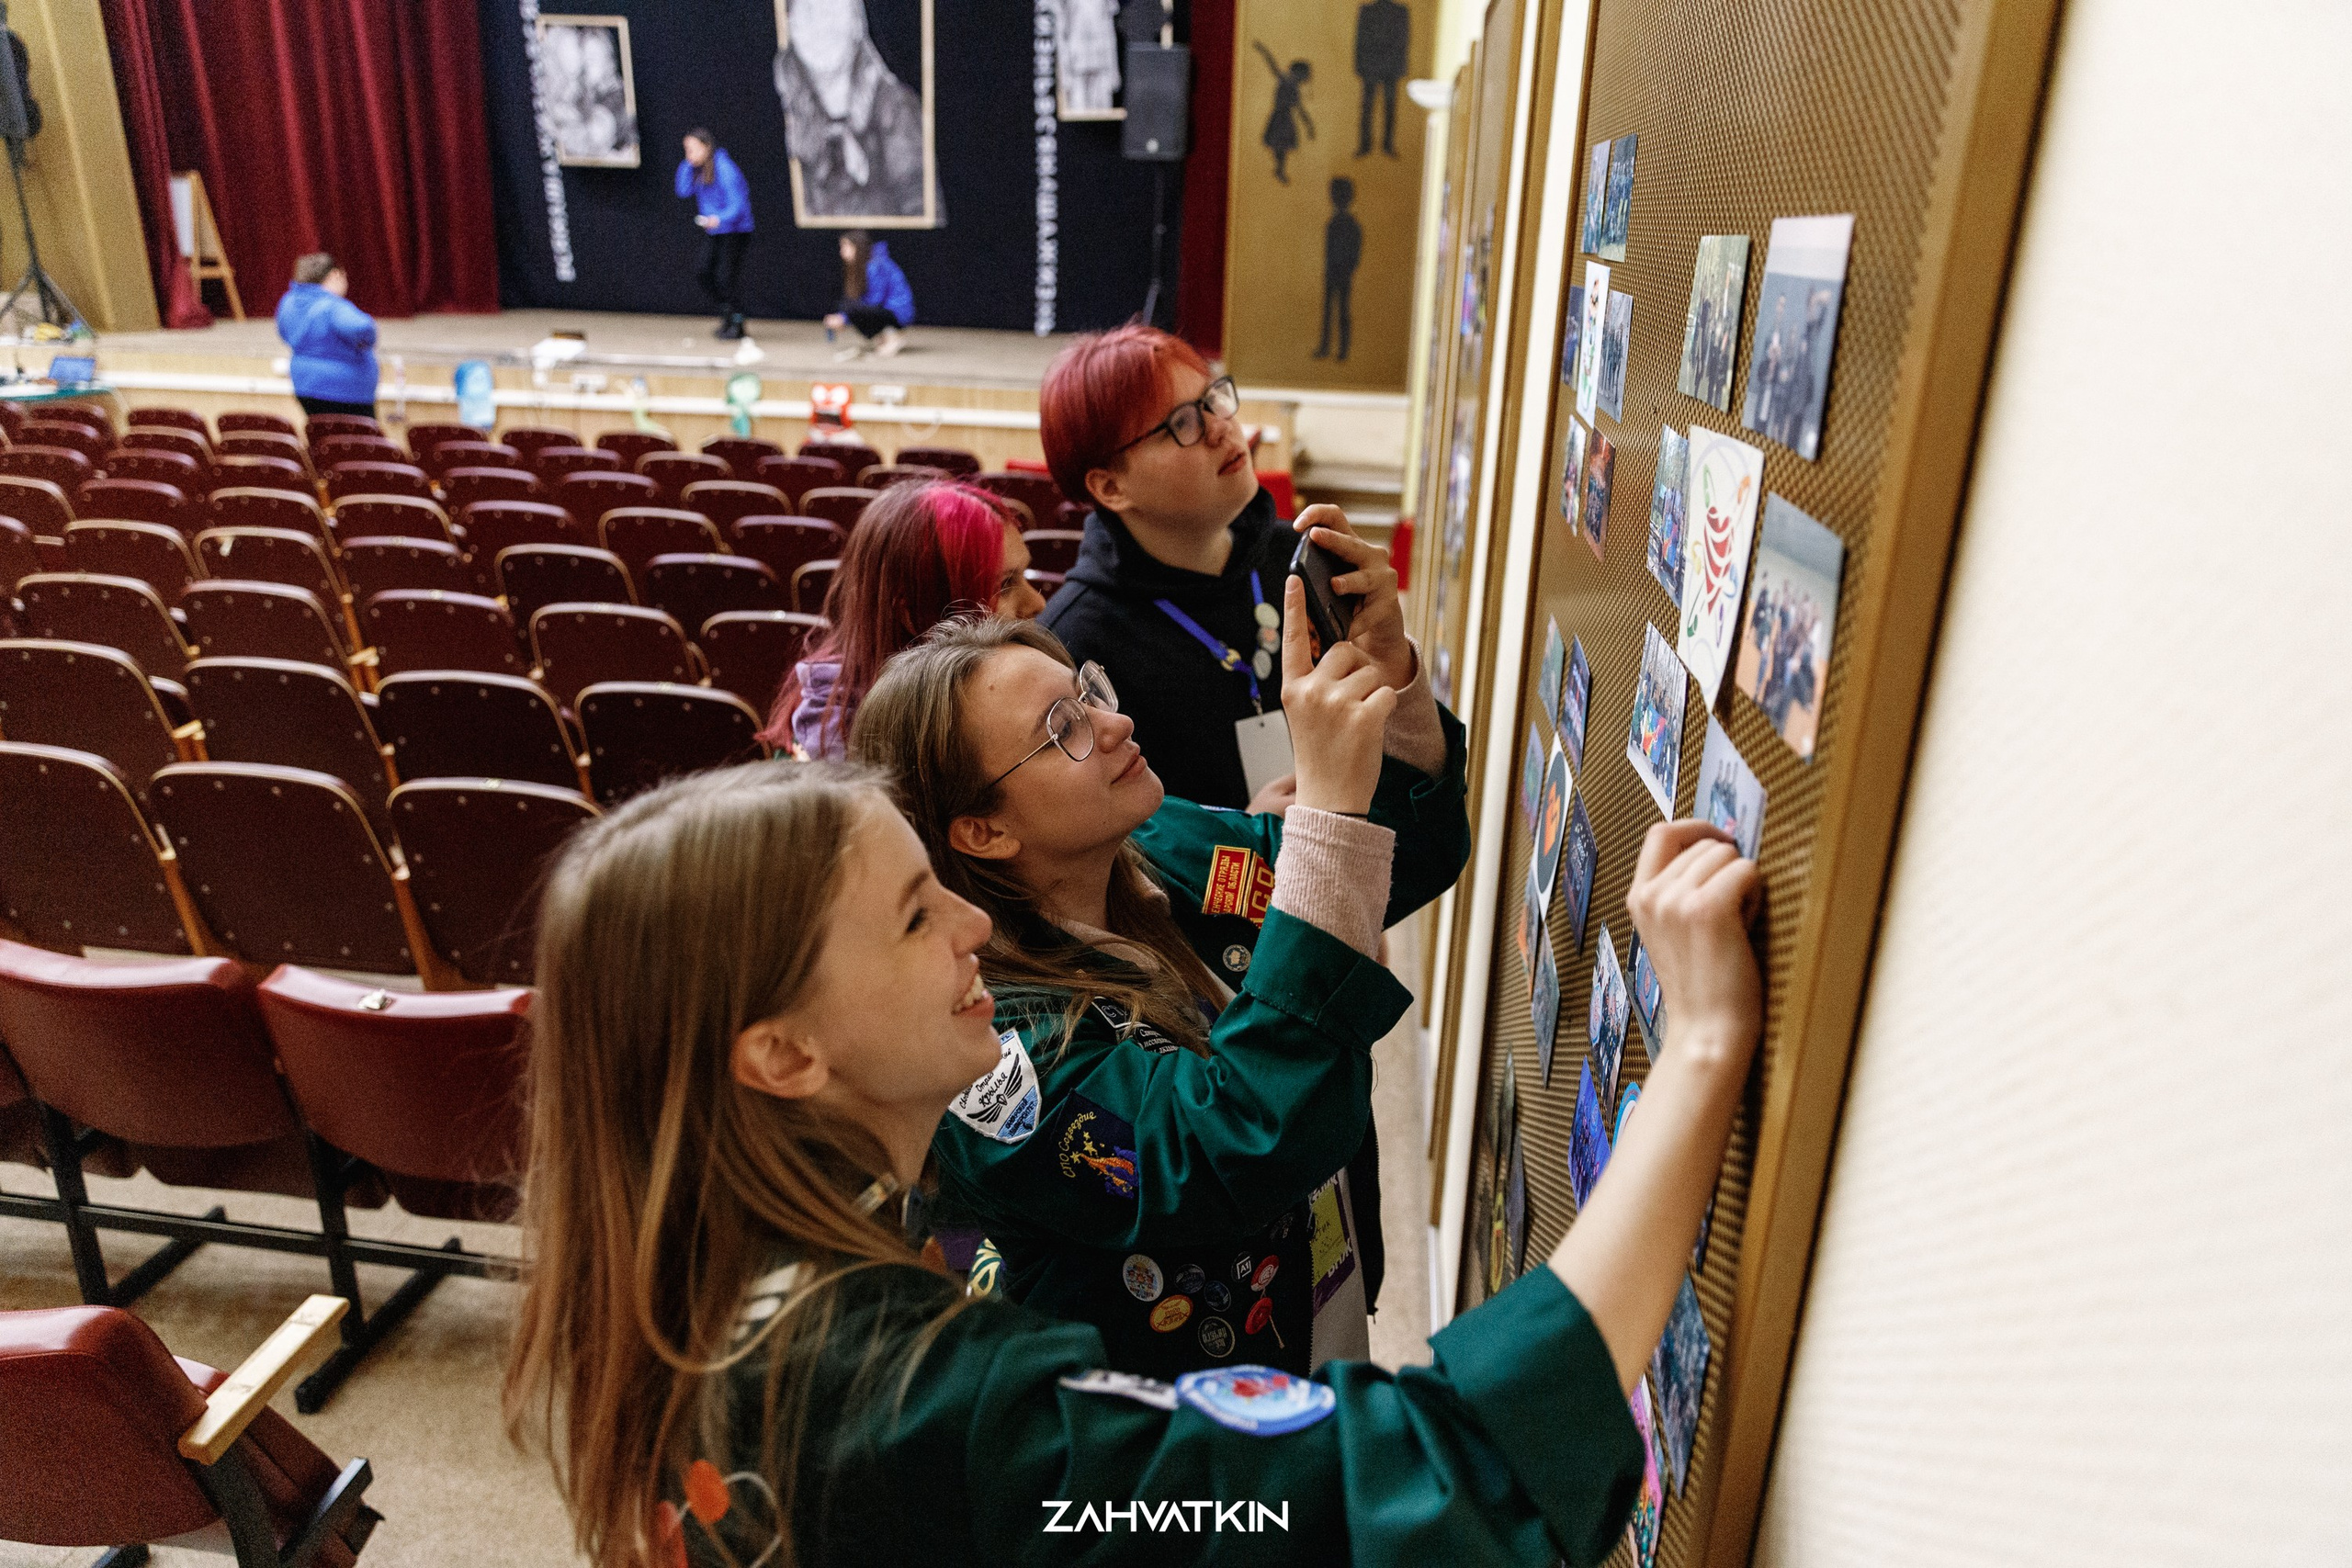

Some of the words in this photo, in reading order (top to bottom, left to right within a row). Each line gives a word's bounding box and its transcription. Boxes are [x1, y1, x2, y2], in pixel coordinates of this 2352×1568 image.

[1217, 855, 1231, 883] ОТРЯДЫ
[1227, 862, 1241, 889] ОБЛАСТИ
[1211, 884, 1225, 914] ЕНЧЕСКИЕ
[1223, 891, 1235, 914] АРСКОЙ
[978, 1072, 1008, 1108] Крылья
[1057, 1111, 1097, 1151] Созвездие
[1059, 1153, 1076, 1178] СПО
